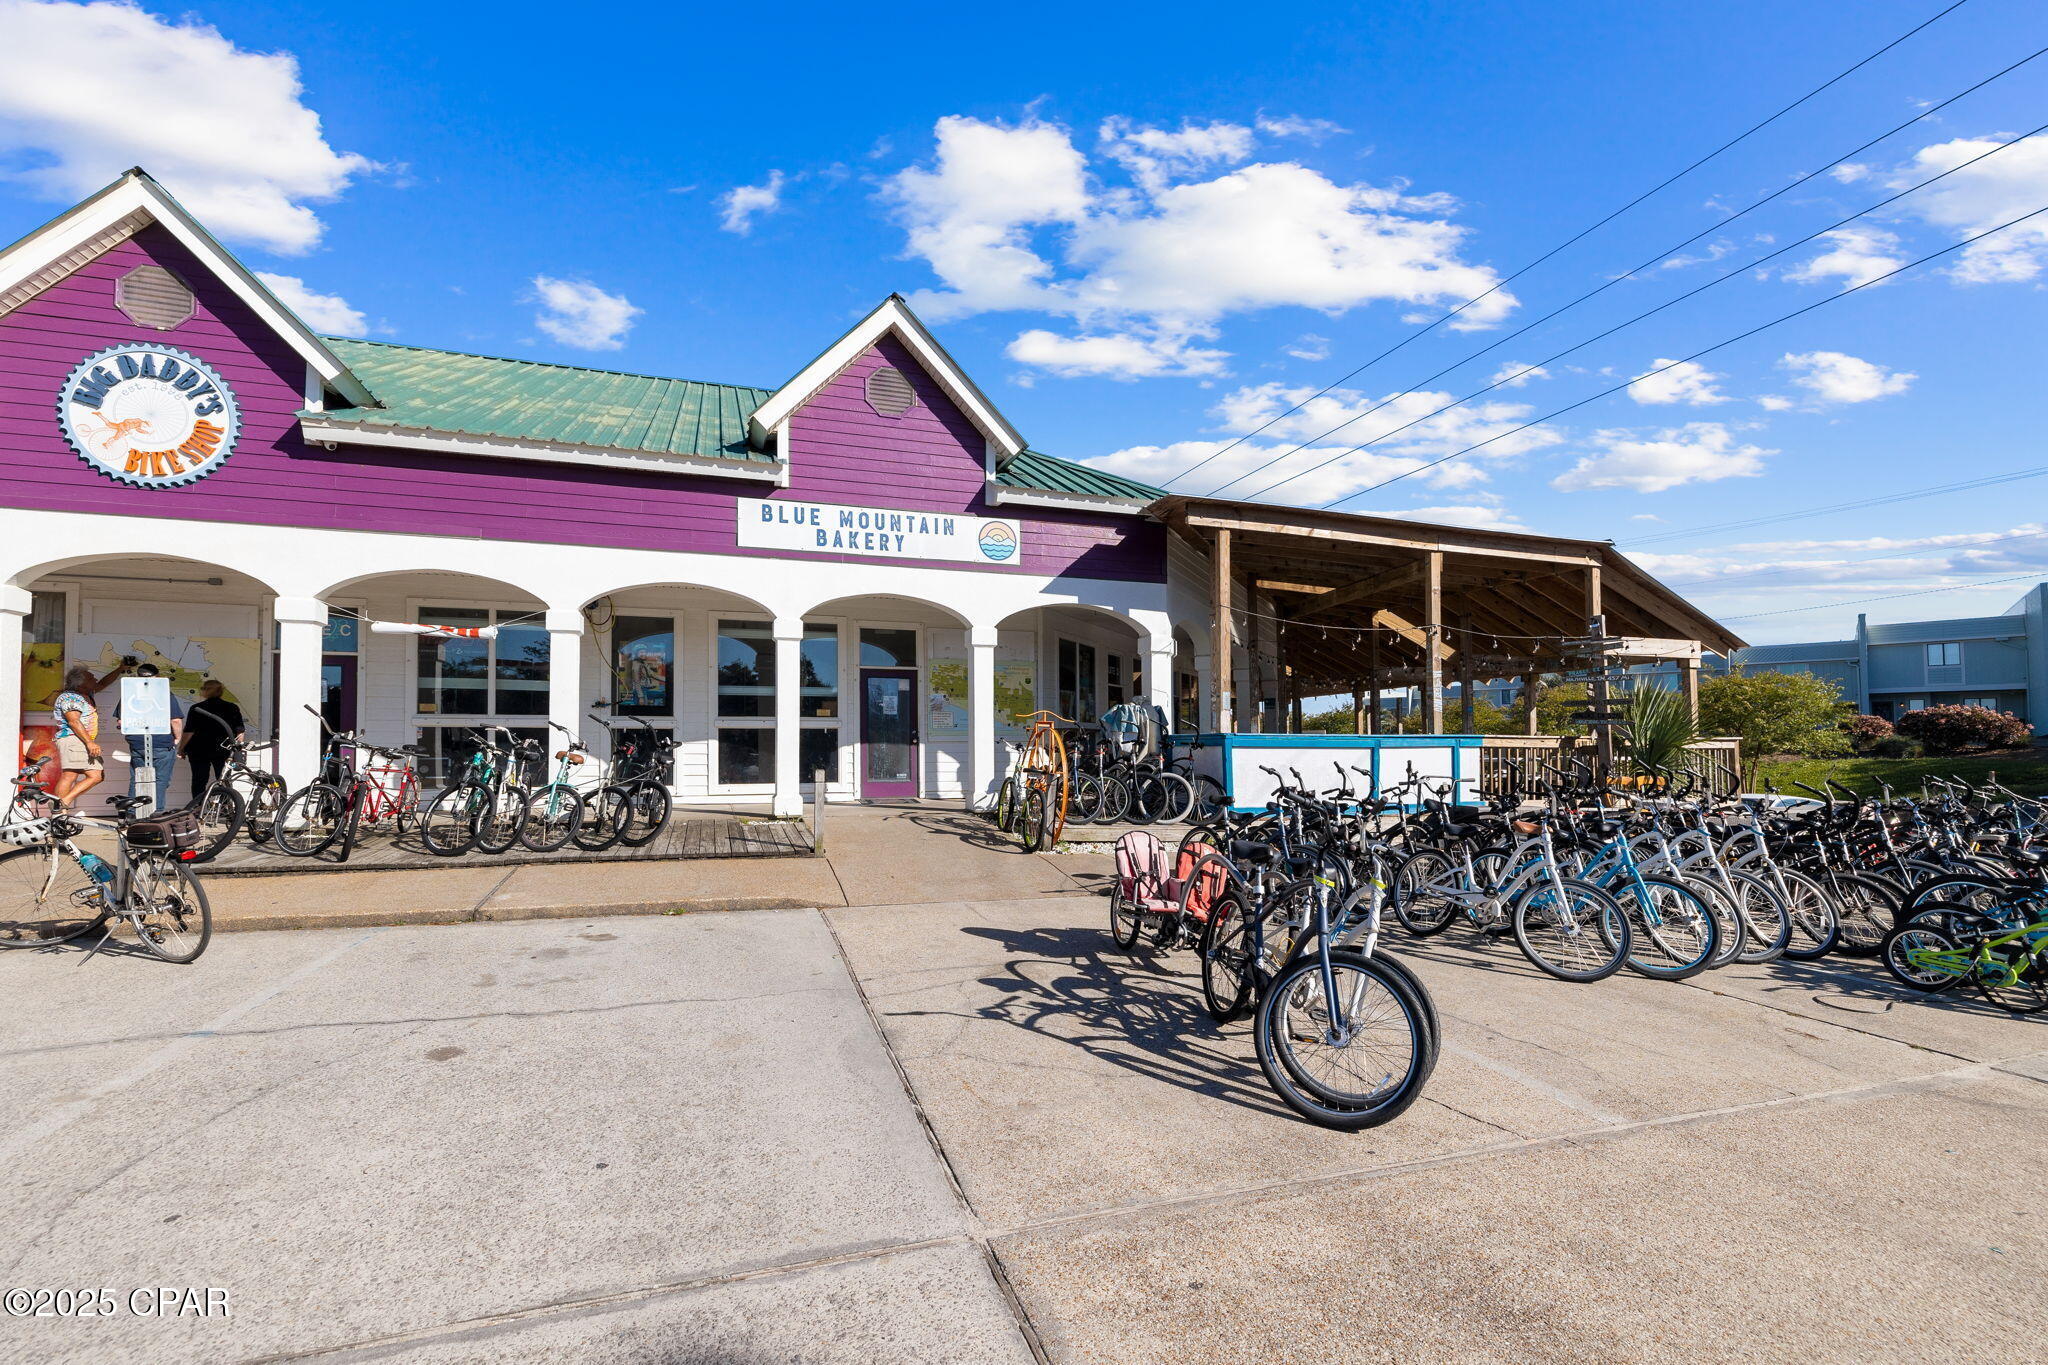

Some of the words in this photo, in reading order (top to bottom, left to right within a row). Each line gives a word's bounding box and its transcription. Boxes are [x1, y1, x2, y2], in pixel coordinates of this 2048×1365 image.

[71, 365, 121, 410] BIG
[117, 354, 225, 417] DADDY'S
[124, 447, 185, 477] BIKE
[177, 418, 225, 466] SHOP
[761, 504, 821, 526] BLUE
[839, 510, 955, 536] MOUNTAIN
[816, 529, 905, 552] BAKERY
